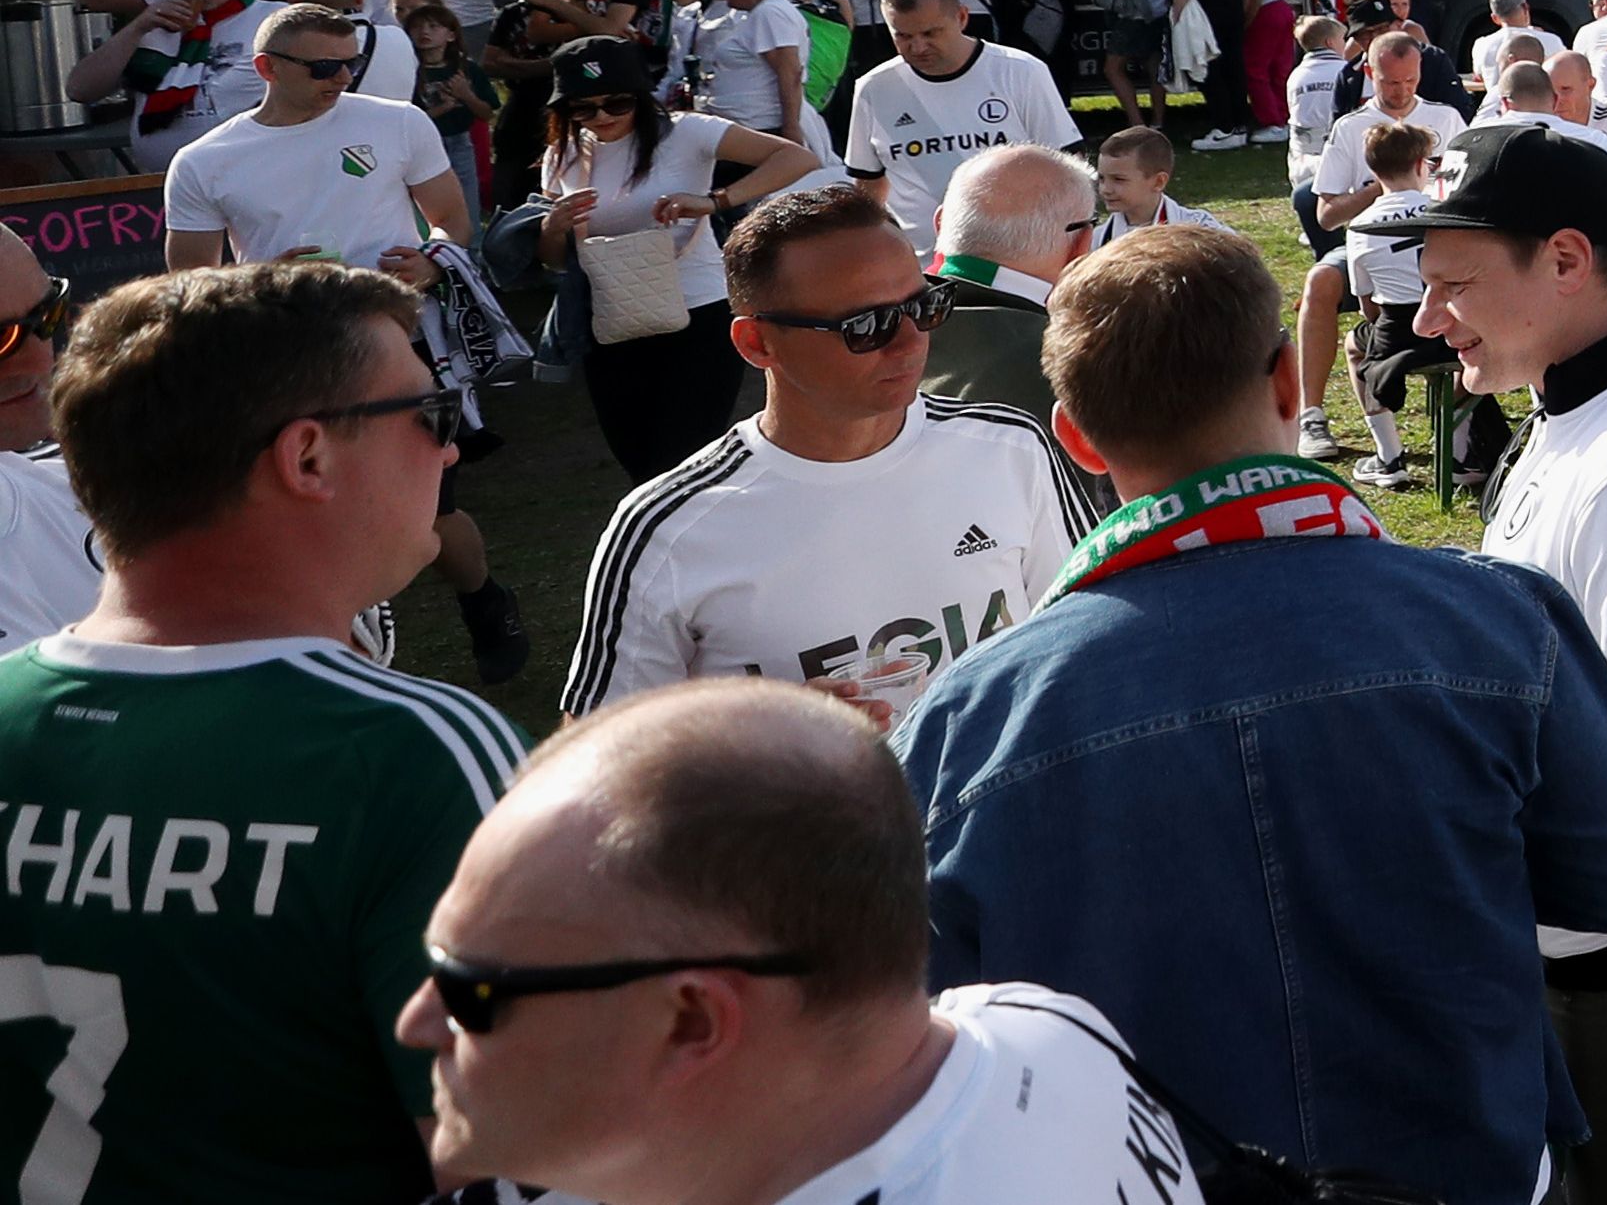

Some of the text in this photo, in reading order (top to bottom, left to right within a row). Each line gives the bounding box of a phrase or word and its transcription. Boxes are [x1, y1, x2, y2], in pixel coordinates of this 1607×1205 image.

[889, 130, 1009, 161] FORTUNA
[953, 538, 998, 557] adidas
[743, 587, 1016, 683] EGIA
[0, 800, 320, 918] HART
